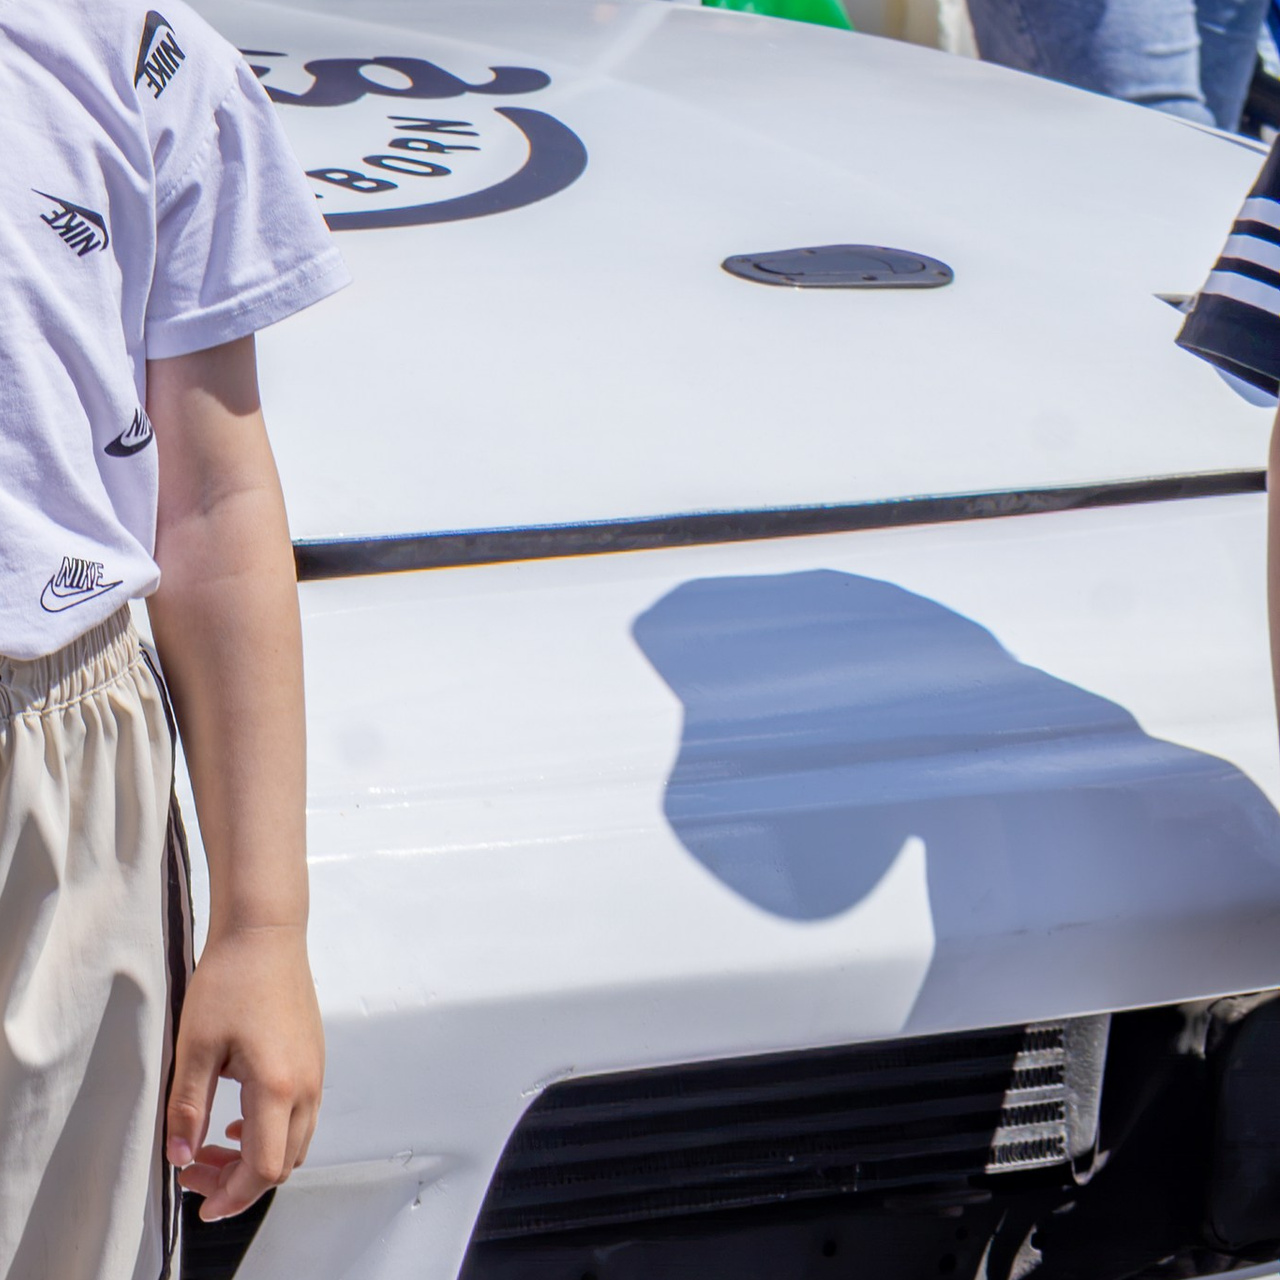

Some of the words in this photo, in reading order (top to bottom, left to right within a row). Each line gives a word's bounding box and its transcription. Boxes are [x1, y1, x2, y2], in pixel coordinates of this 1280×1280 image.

[144, 31, 186, 100] NIKE
[39, 210, 101, 257] NIKE
[55, 556, 104, 590] NIKE
